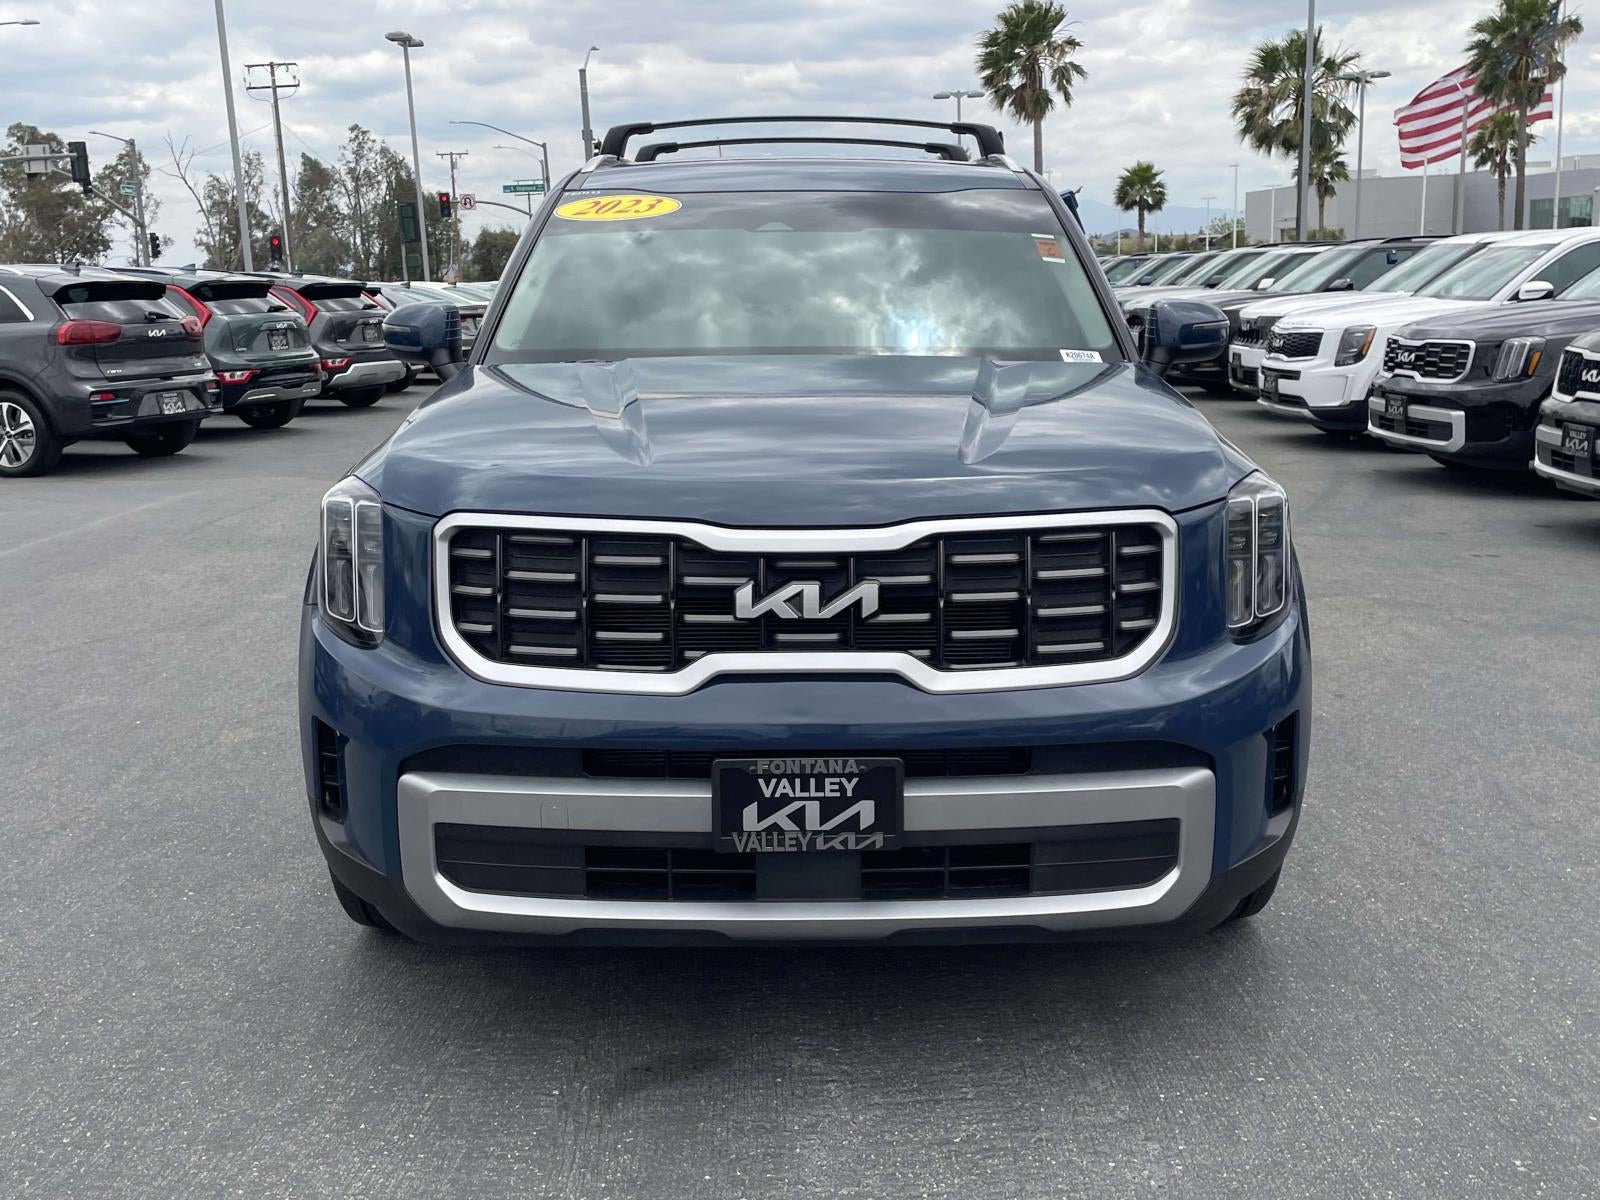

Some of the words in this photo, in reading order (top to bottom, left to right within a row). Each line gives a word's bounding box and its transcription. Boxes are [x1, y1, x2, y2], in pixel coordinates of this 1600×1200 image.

[571, 198, 664, 216] 2023
[148, 329, 167, 337] KIA
[1397, 351, 1416, 362] KIA
[1565, 438, 1589, 451] KIA
[735, 580, 880, 619] KIA
[757, 760, 860, 774] FONTANA
[758, 777, 859, 798] VALLEY
[743, 800, 876, 831] KIA
[732, 832, 812, 852] VALLEY
[815, 832, 885, 850] KIA
